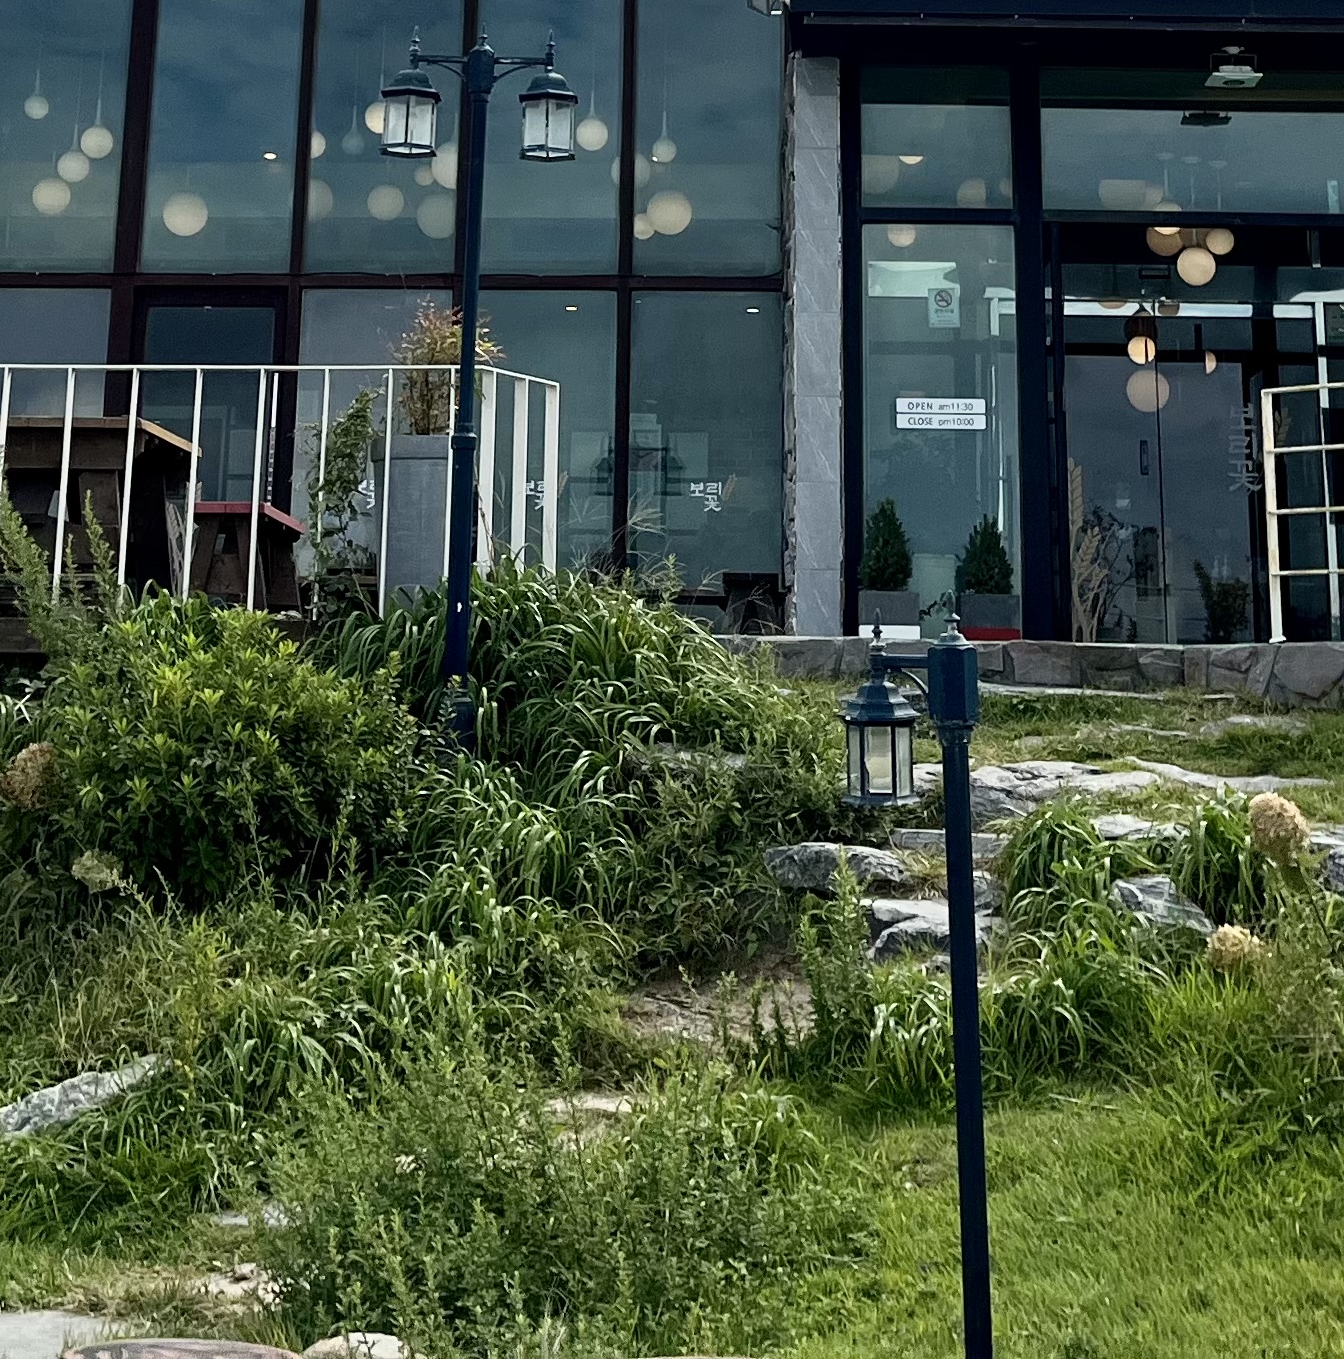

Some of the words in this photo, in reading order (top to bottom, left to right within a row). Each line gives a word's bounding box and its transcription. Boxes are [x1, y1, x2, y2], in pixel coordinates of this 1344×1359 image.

[907, 401, 933, 411] OPEN
[907, 416, 933, 426] CLOSE
[689, 481, 723, 497] 보리
[703, 494, 722, 512] 꽃
